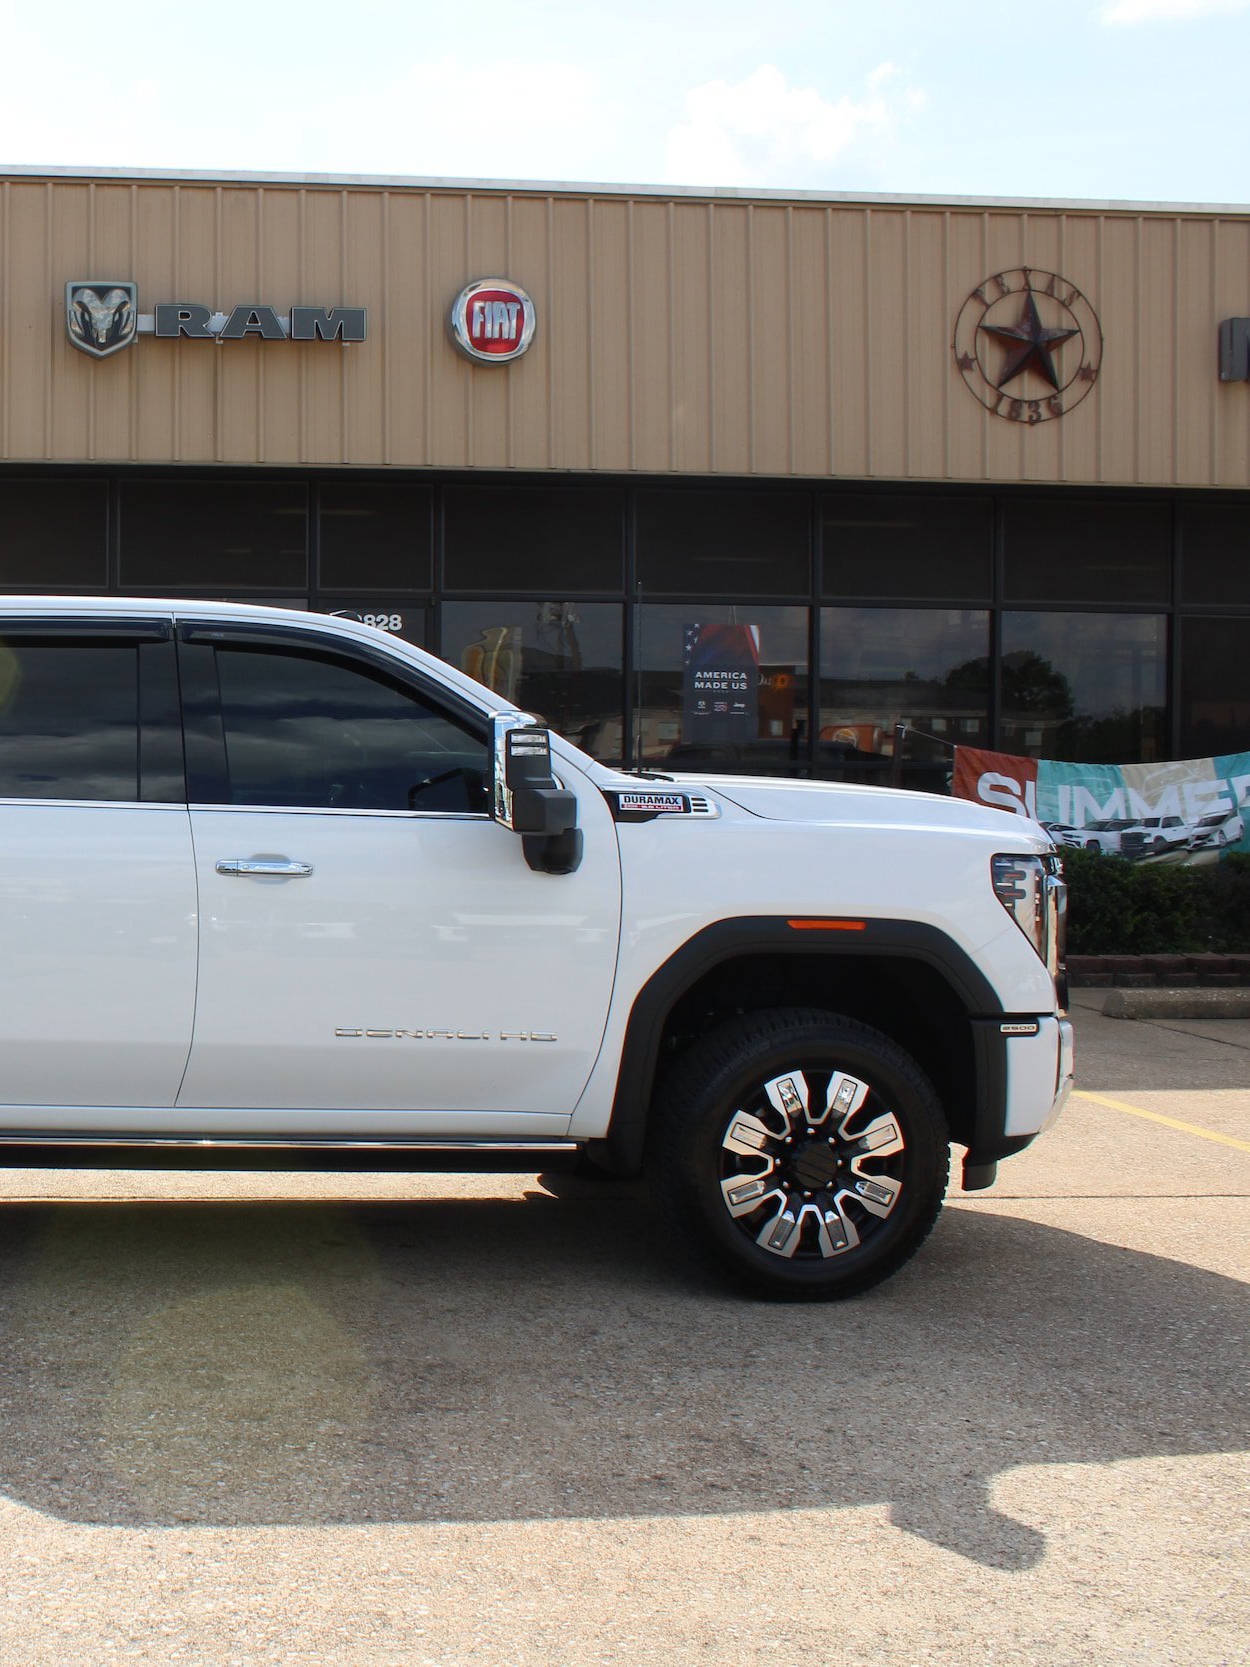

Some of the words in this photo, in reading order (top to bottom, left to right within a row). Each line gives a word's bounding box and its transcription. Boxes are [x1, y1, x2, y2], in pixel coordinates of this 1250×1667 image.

[154, 303, 367, 341] RAM
[472, 301, 520, 339] FIAT
[357, 614, 403, 631] 828
[695, 671, 747, 680] AMERICA
[694, 682, 728, 690] MADE
[731, 682, 748, 690] US
[623, 795, 679, 805] DURAMAX
[335, 1026, 490, 1040] DENALI
